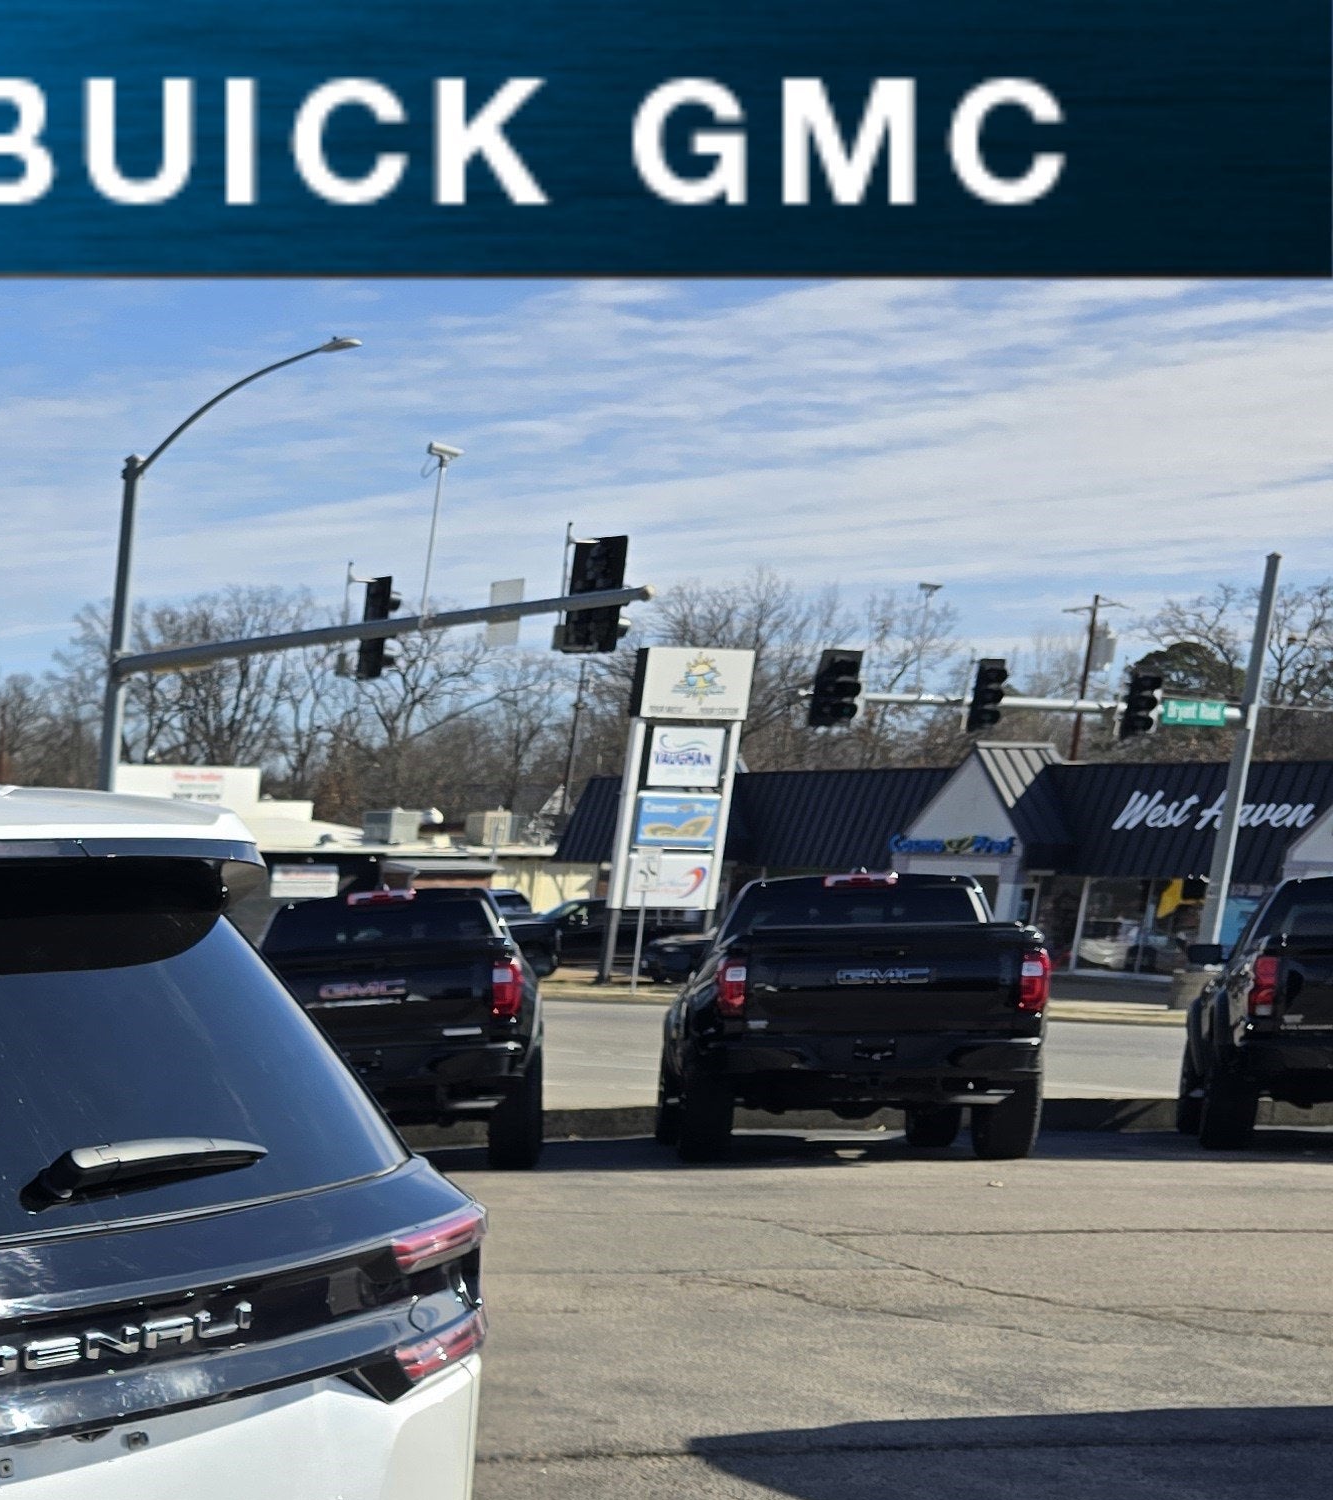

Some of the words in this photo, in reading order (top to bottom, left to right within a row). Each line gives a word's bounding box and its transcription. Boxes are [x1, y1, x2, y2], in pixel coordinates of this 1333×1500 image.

[654, 752, 711, 766] VAUGHAN
[1111, 790, 1200, 831] West
[1194, 789, 1316, 831] Haven
[836, 966, 931, 985] GMC
[319, 979, 407, 998] GMC
